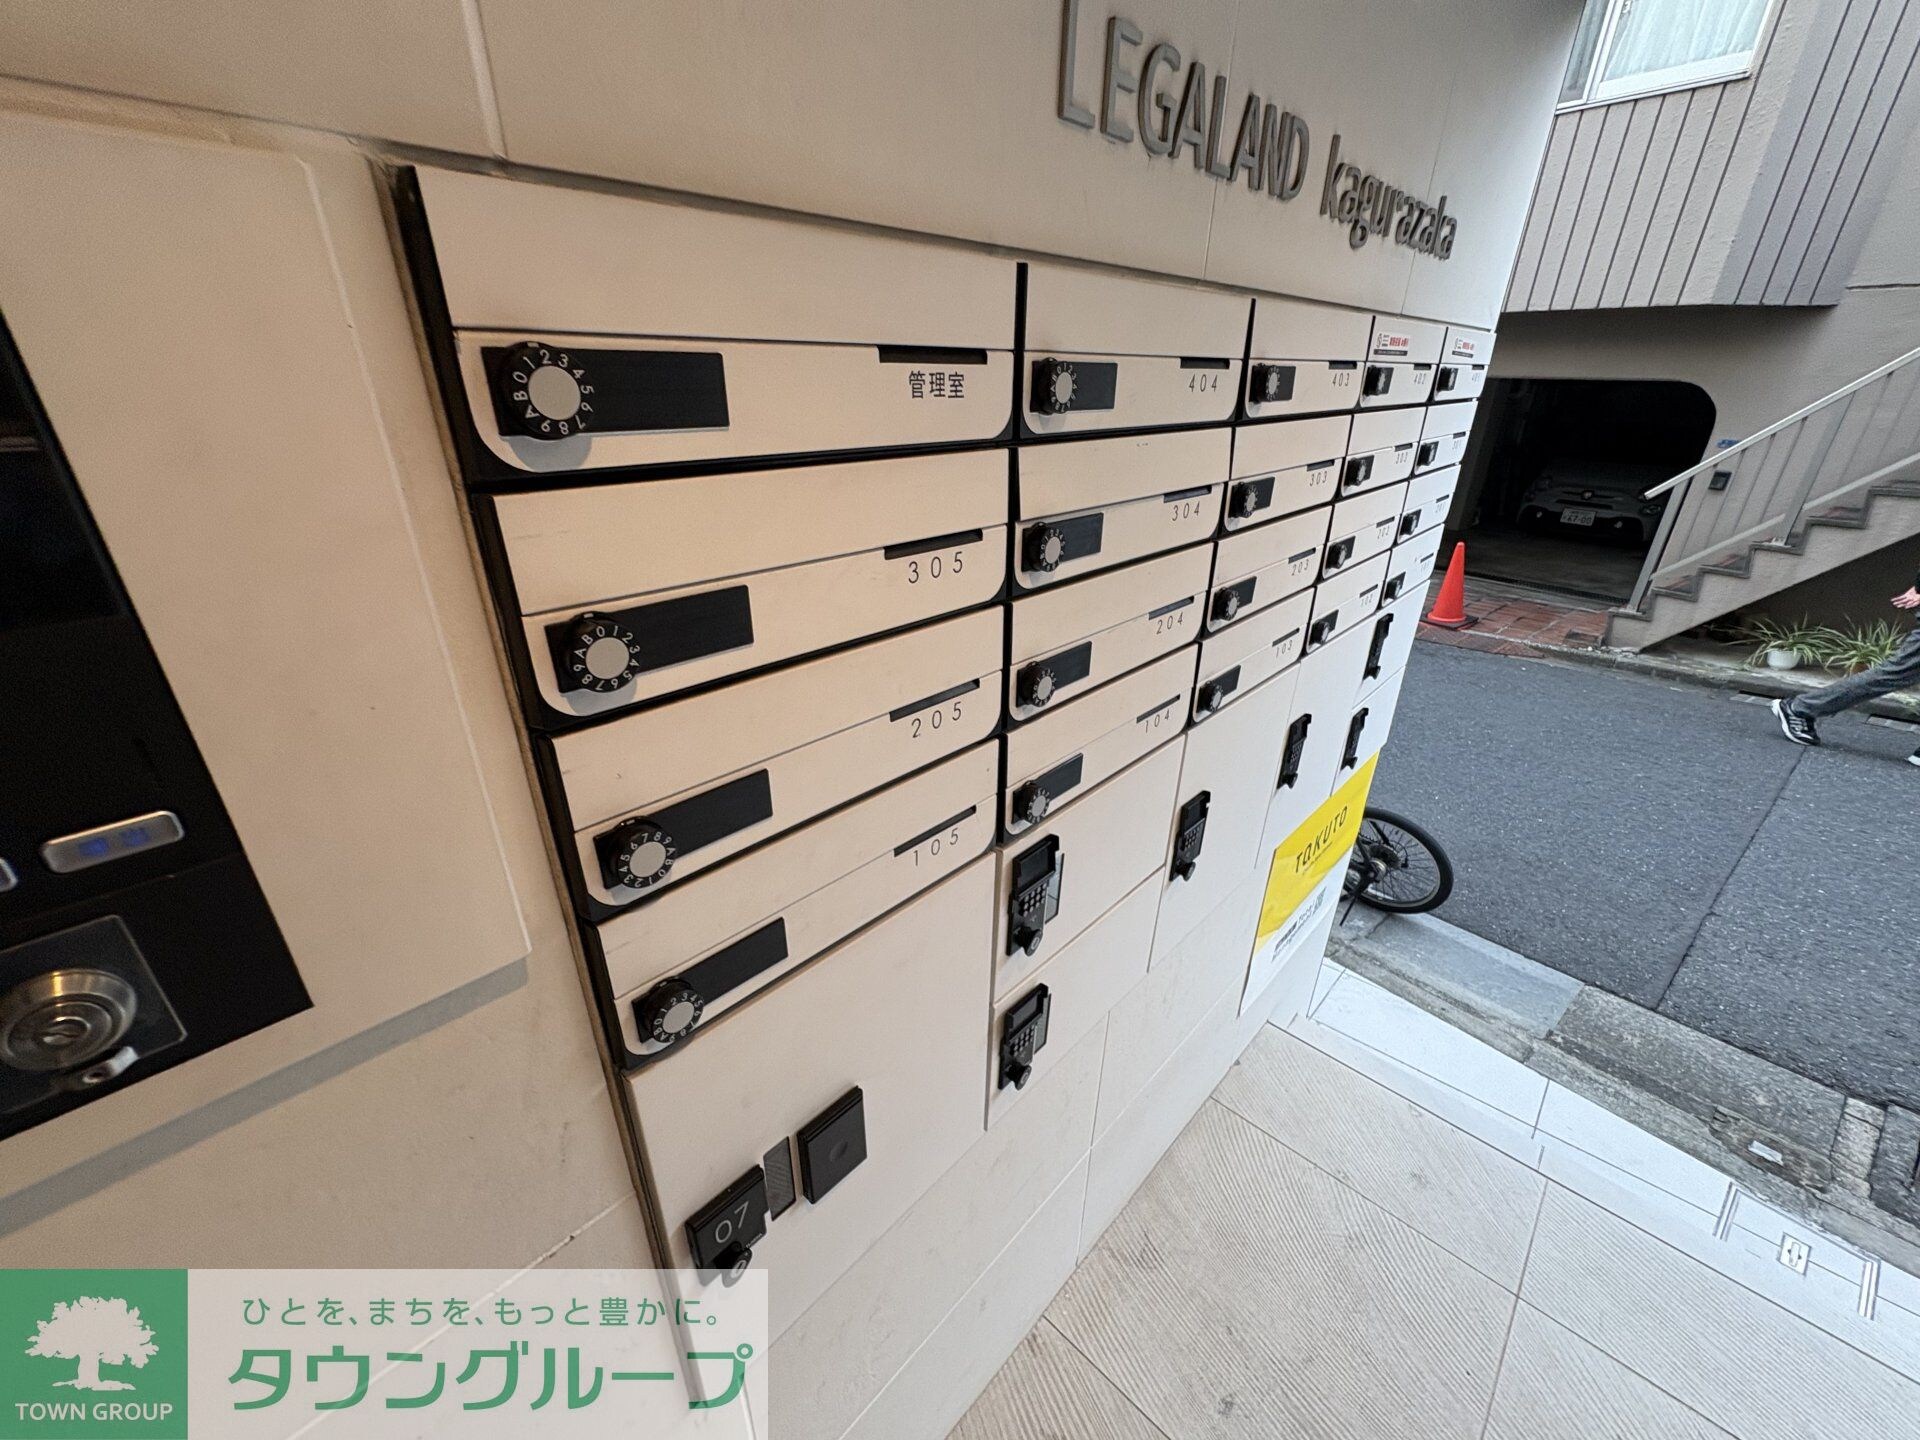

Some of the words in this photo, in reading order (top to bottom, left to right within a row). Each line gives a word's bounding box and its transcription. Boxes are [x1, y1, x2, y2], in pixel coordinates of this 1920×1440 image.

[1058, 0, 1309, 200] LEGALAND
[1321, 134, 1457, 260] kagurazaka
[908, 371, 965, 400] 管理室
[1189, 373, 1218, 393] 404
[1332, 373, 1350, 387] 403
[1309, 471, 1328, 486] 303
[1172, 502, 1201, 521] 304
[908, 551, 962, 584] 305
[1291, 559, 1310, 577] 203
[1157, 613, 1184, 635] 204
[1276, 639, 1293, 658] 103
[911, 701, 962, 739] 205
[1144, 709, 1171, 733] 104
[913, 827, 959, 866] 105
[715, 1201, 750, 1244] 07
